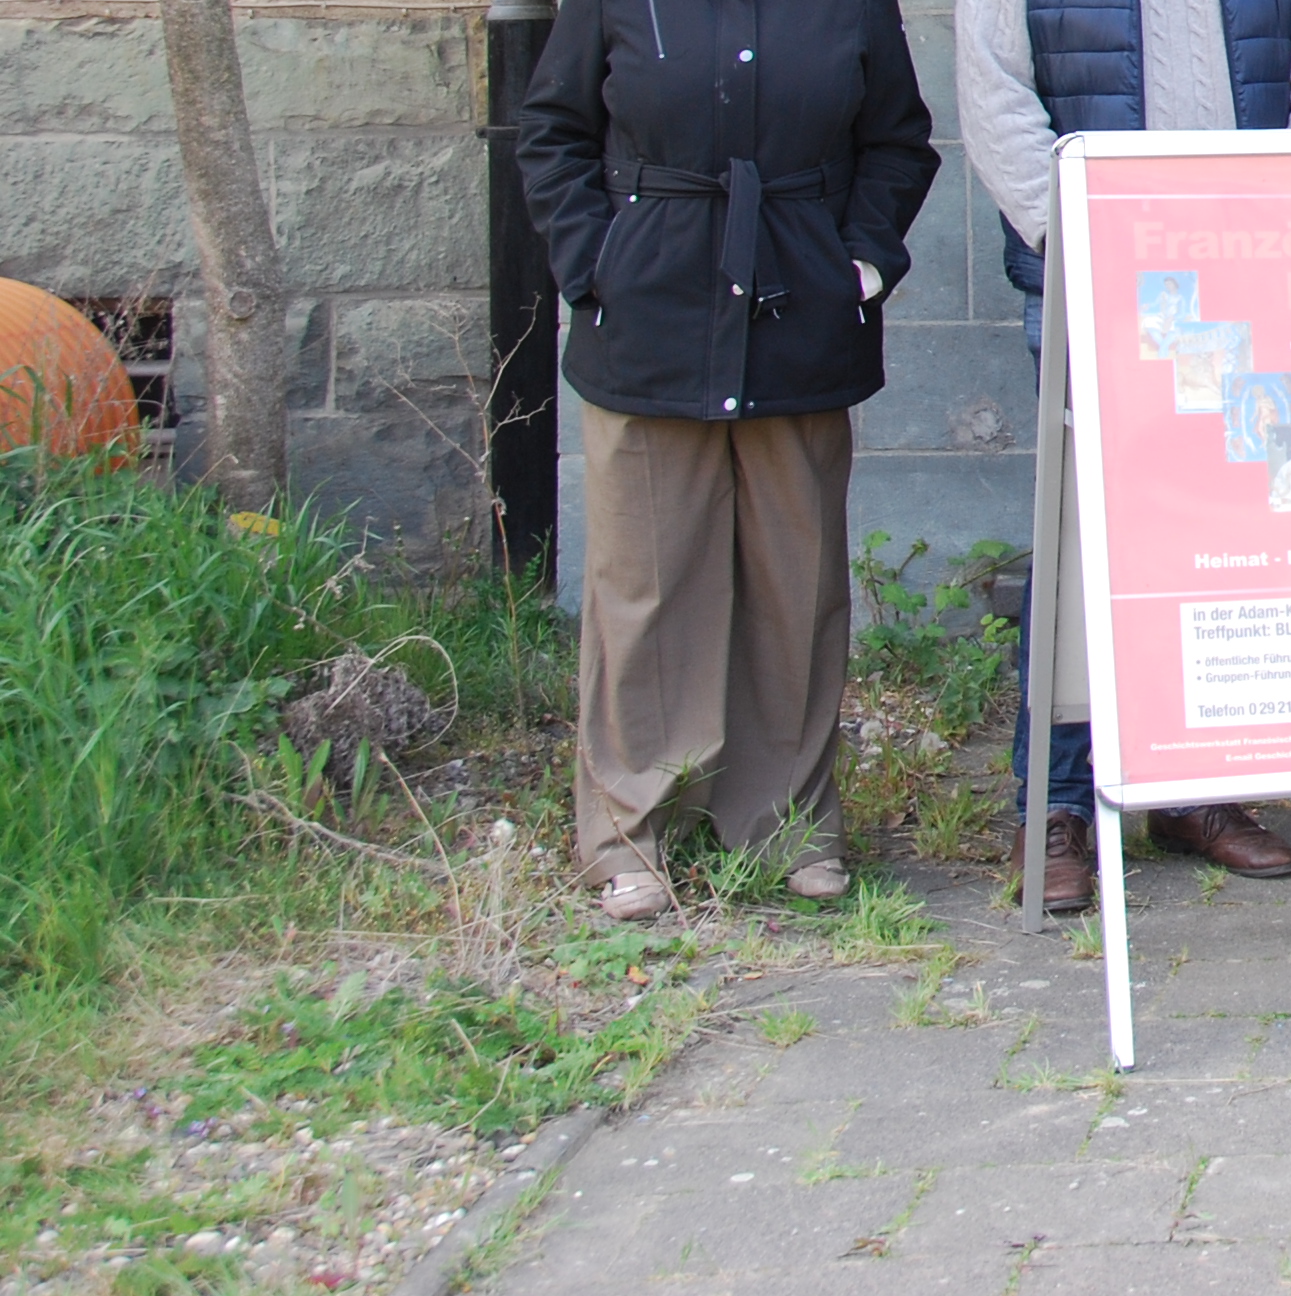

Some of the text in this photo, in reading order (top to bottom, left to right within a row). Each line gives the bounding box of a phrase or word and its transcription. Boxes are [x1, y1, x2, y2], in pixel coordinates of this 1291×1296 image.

[1194, 551, 1269, 569] Heimat
[1193, 608, 1206, 621] in
[1210, 607, 1233, 621] der
[1193, 623, 1270, 641] Treffpunkt:
[1204, 654, 1260, 667] öffentliche
[1197, 703, 1245, 718] Telefon
